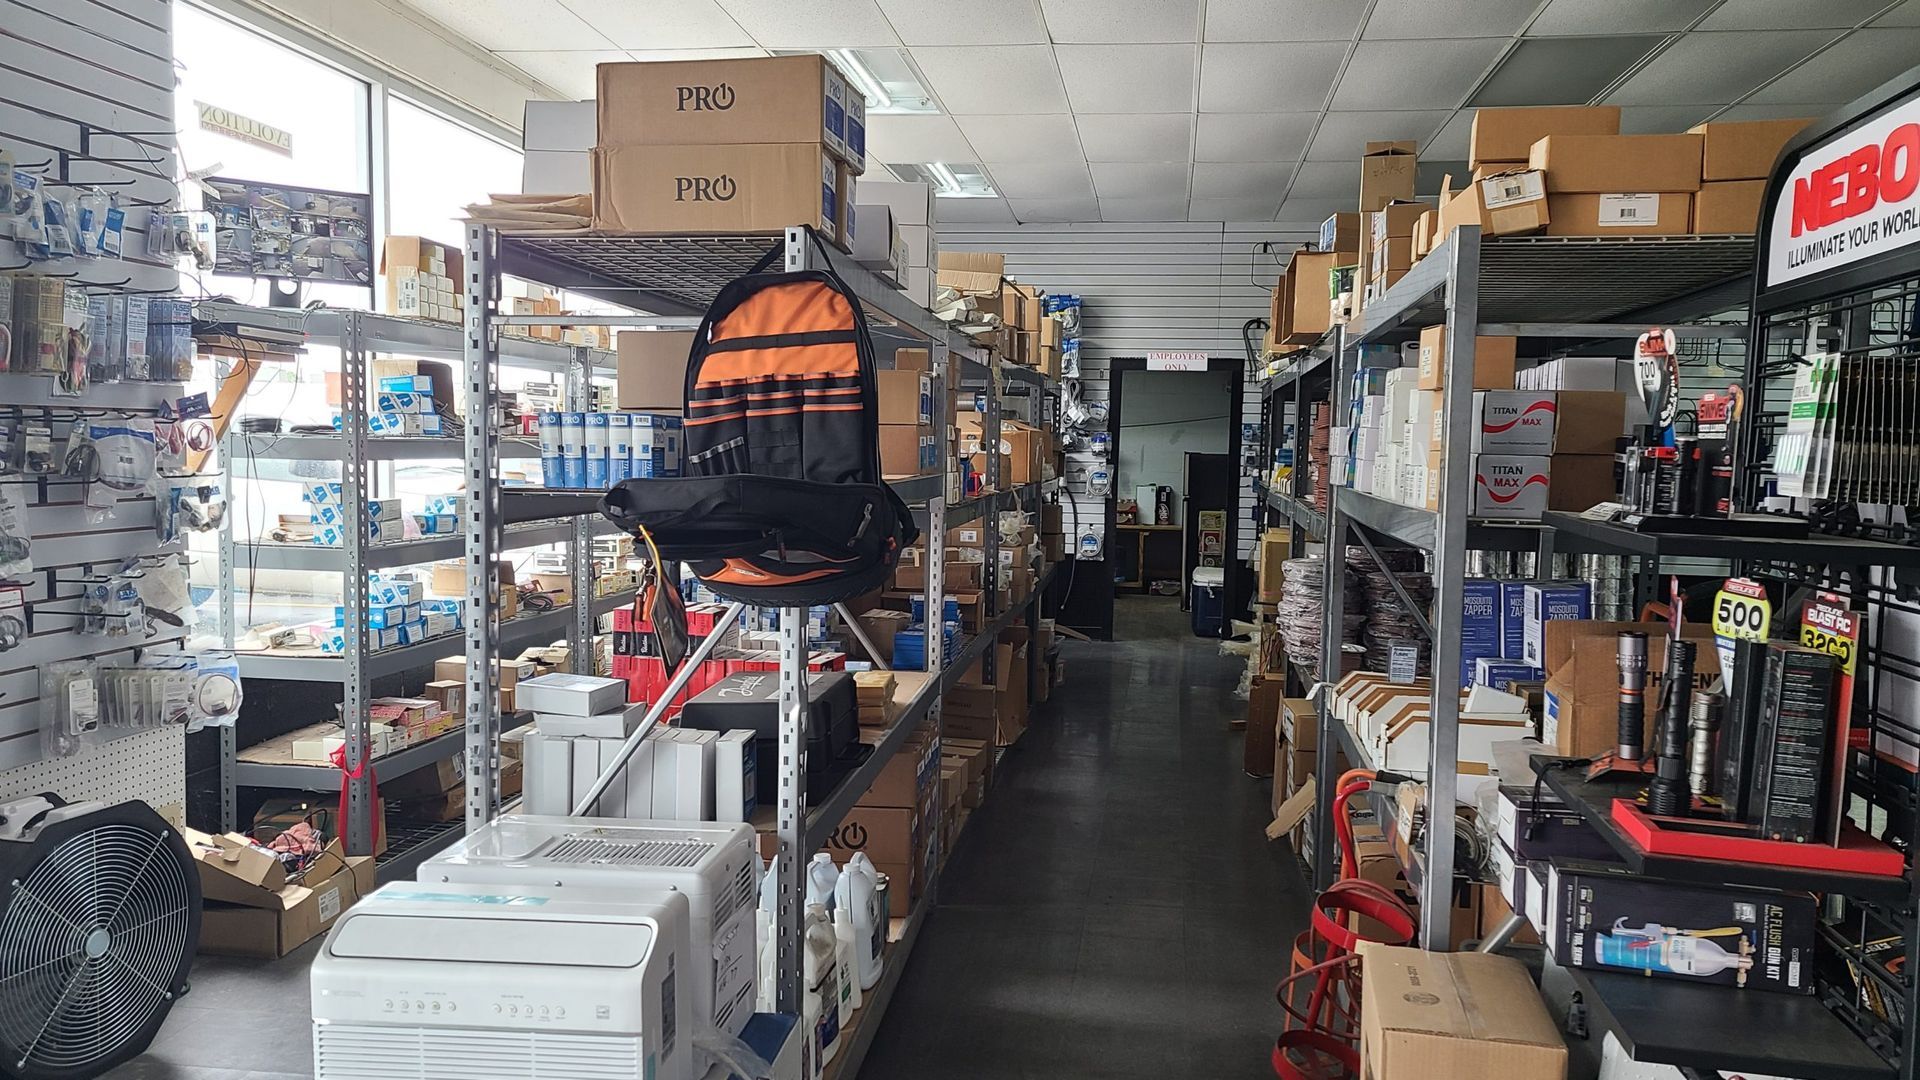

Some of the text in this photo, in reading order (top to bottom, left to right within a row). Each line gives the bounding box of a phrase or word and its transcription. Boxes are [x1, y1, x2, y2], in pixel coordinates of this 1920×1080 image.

[1791, 123, 1920, 239] NEBO
[1788, 207, 1920, 270] ILLUMINATE YOUR WORL
[1149, 352, 1206, 361] EMPLOYEES
[1164, 363, 1189, 371] ONLY
[1639, 361, 1656, 380] 700
[1493, 407, 1519, 415] TITAN
[1522, 418, 1542, 426] MAX
[1491, 465, 1524, 476] TITAN
[1493, 478, 1520, 488] MAX
[1463, 596, 1493, 605] MOSQUITO
[1463, 605, 1493, 616] ZAPPER
[1548, 605, 1579, 614] MOSQUITO
[1718, 598, 1763, 632] 500
[1807, 608, 1839, 630] BLAST
[1766, 904, 1784, 981] AC FLUSH GUN KIT
